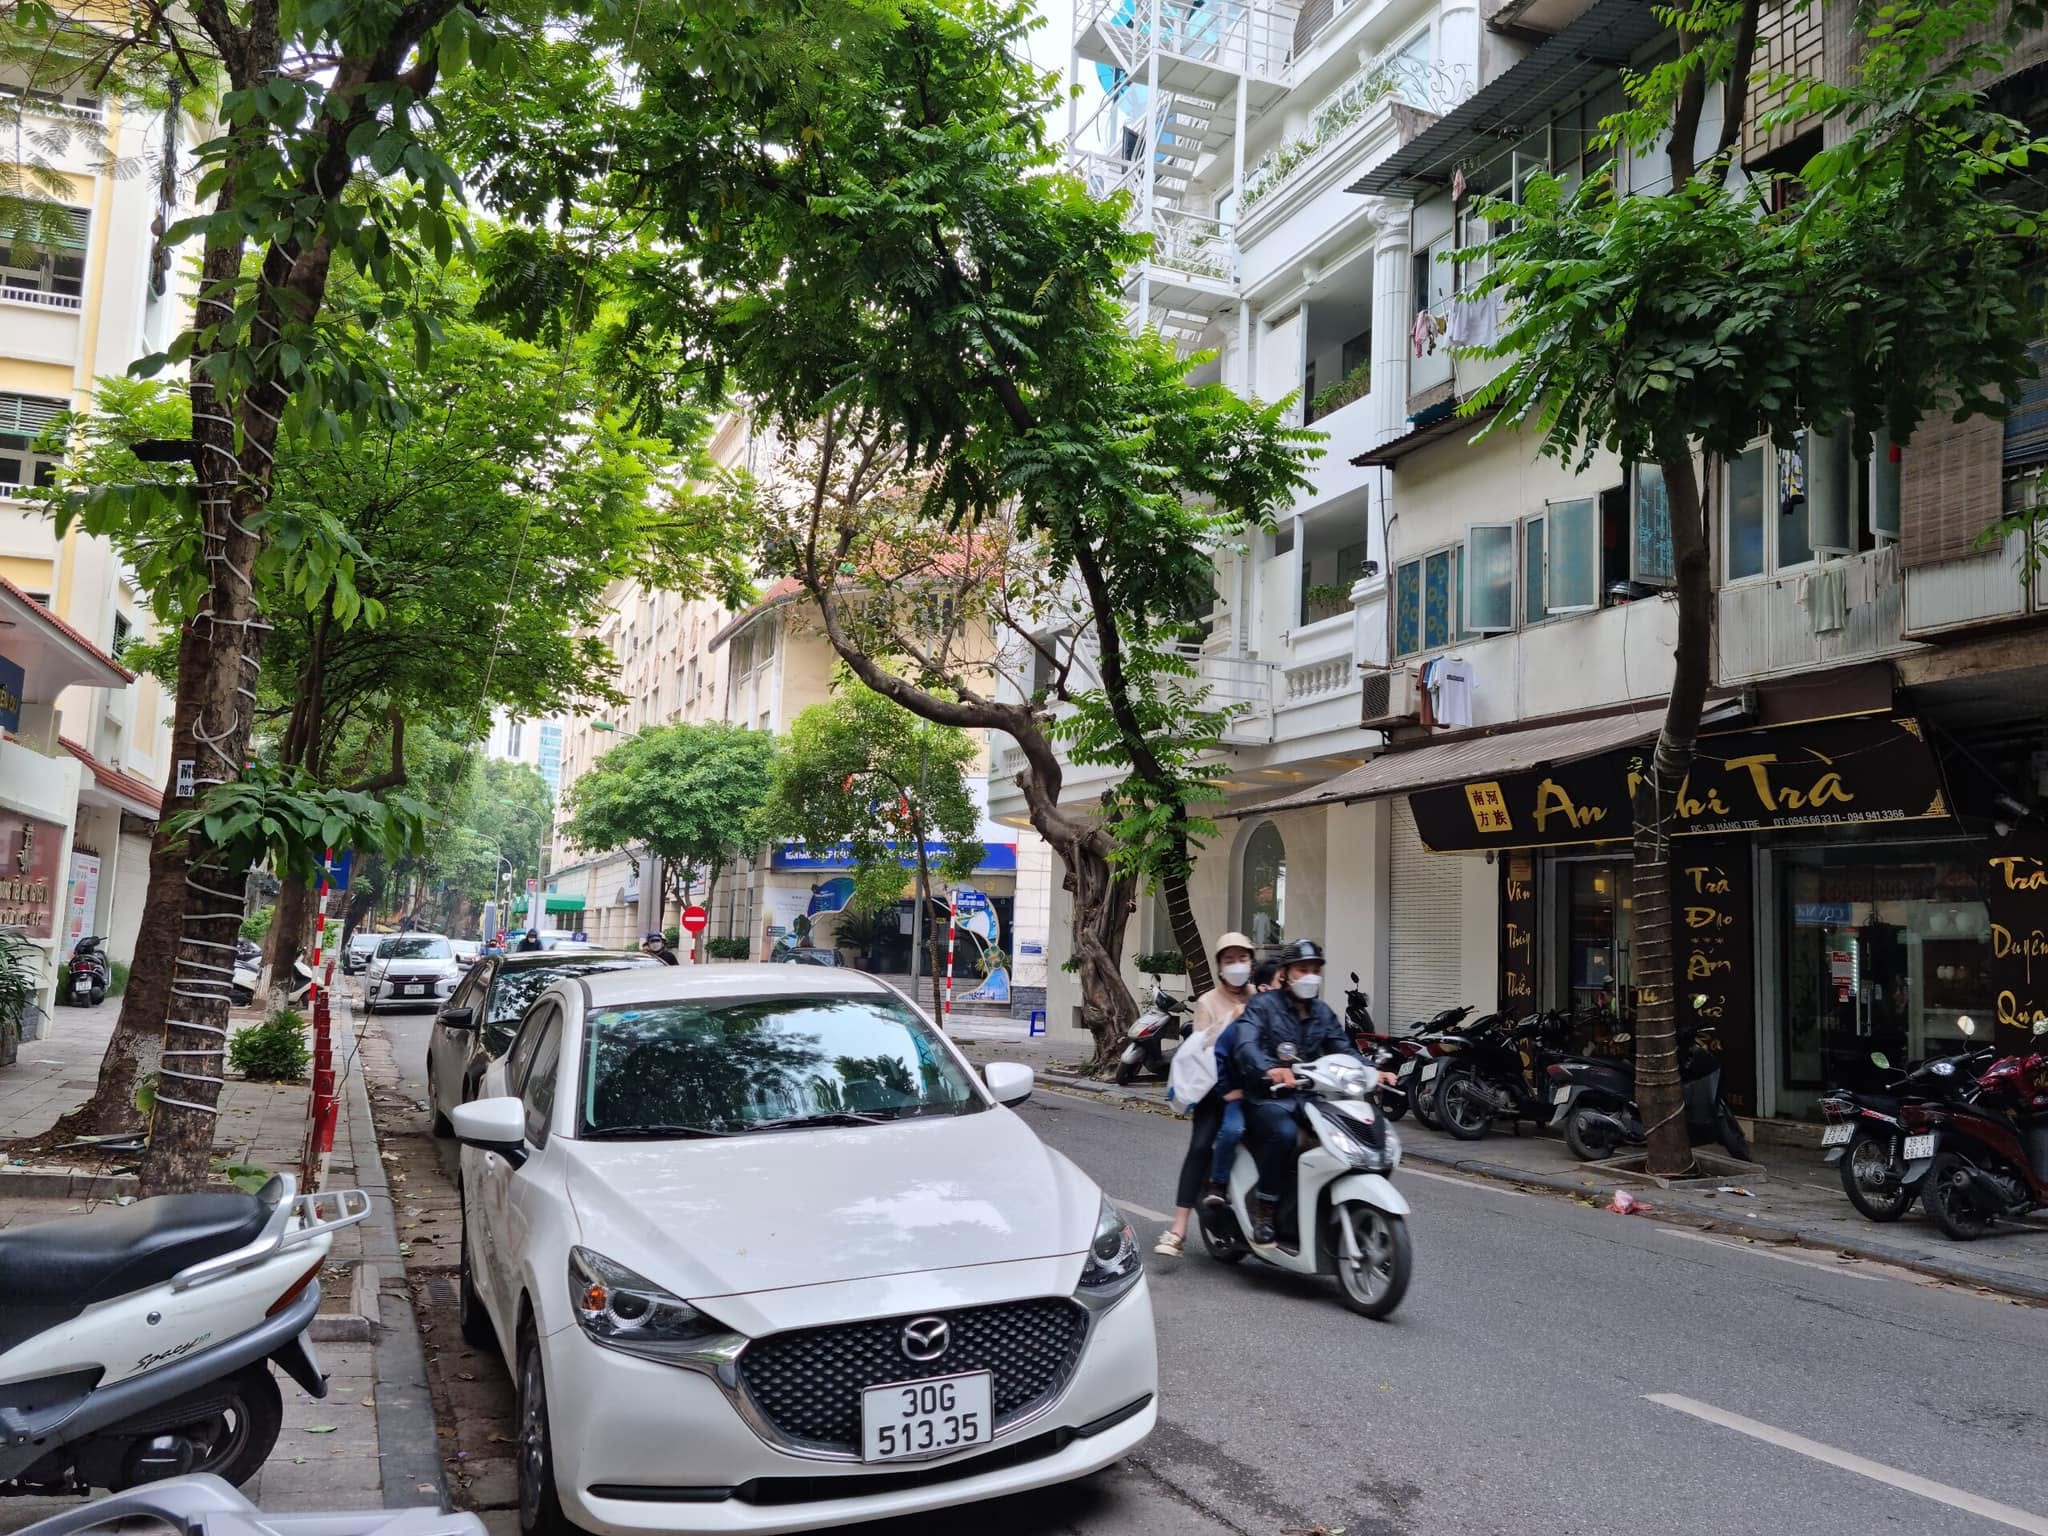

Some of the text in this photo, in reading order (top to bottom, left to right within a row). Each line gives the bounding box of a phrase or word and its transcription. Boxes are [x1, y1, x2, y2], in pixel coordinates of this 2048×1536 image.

[1532, 746, 1854, 832] An hi Trà
[1685, 866, 1731, 894] Trà
[1988, 857, 2048, 890] Trà
[1990, 923, 2048, 985] Duyên
[128, 1337, 202, 1373] Spacy
[901, 1383, 956, 1417] 30G
[879, 1412, 978, 1455] 513.35
